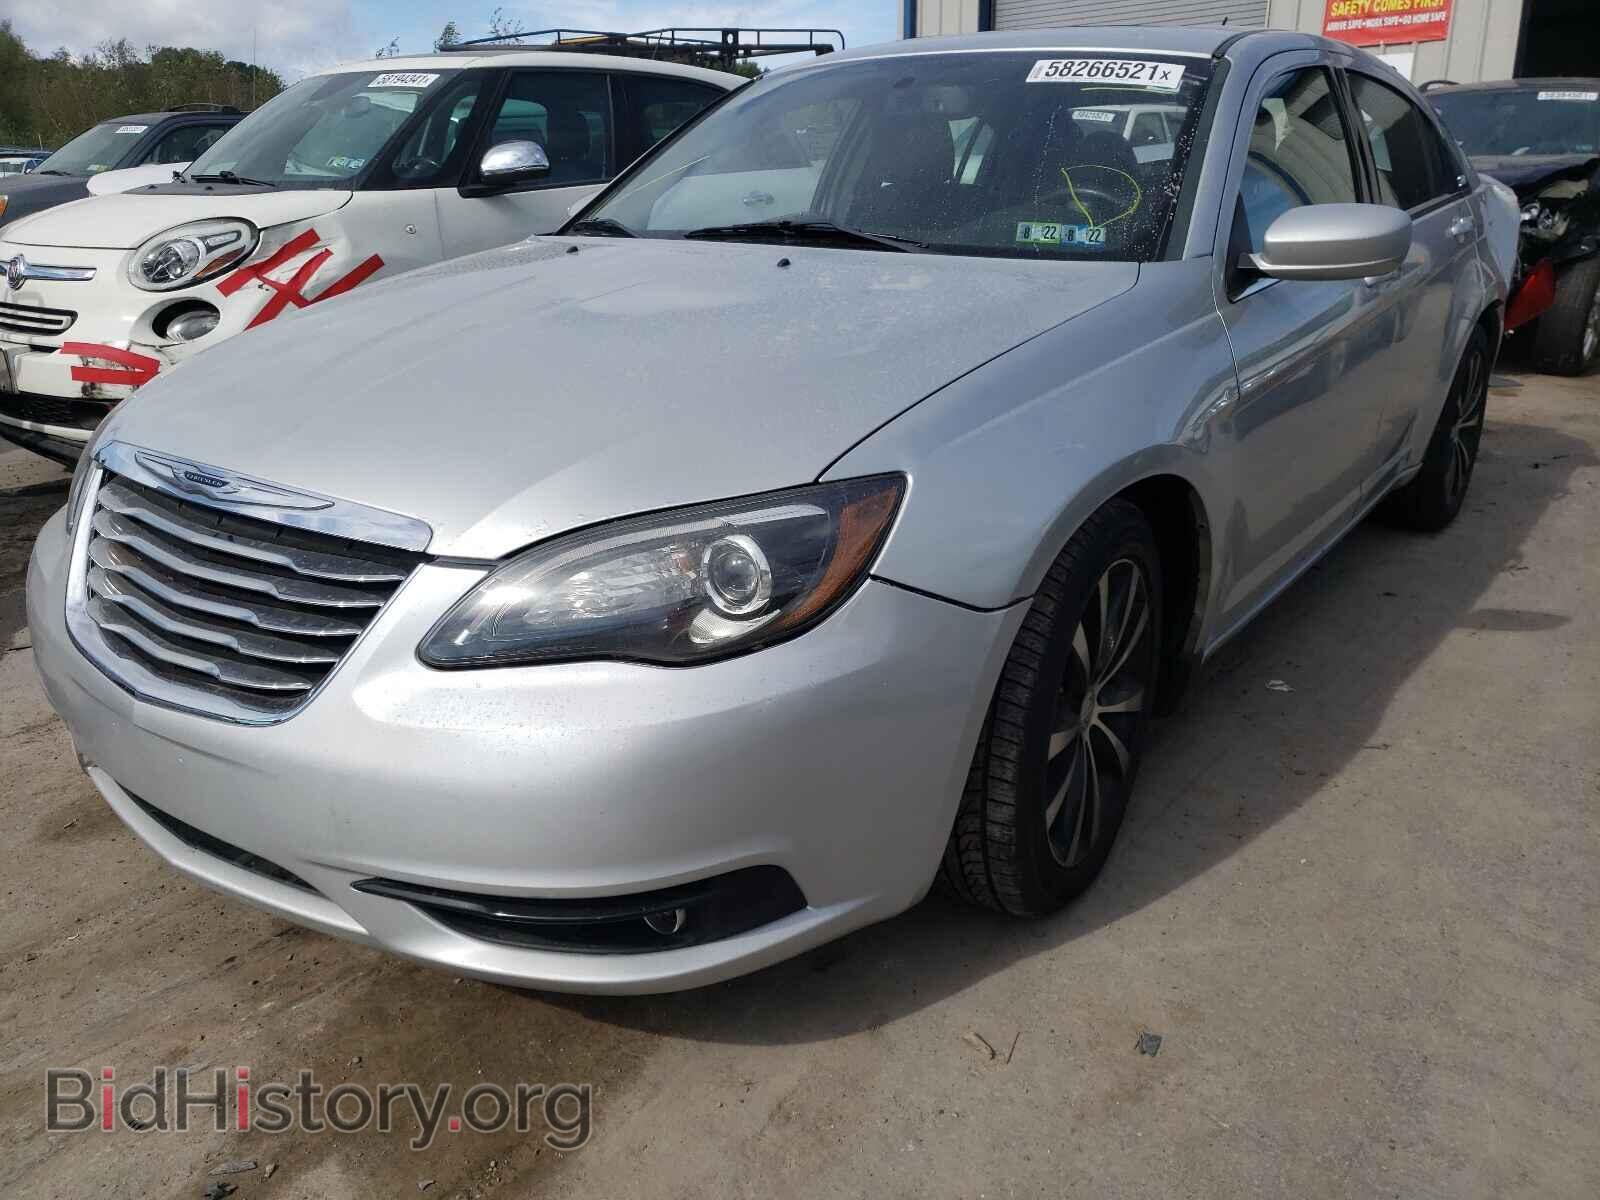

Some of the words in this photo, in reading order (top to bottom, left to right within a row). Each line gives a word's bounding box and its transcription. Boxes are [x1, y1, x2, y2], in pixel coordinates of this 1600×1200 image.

[1331, 0, 1370, 17] SAFETY
[1373, 0, 1411, 12] COMES
[1023, 225, 1031, 240] 8
[1043, 225, 1057, 240] 22
[1067, 229, 1075, 242] 8
[1088, 228, 1101, 243] 22
